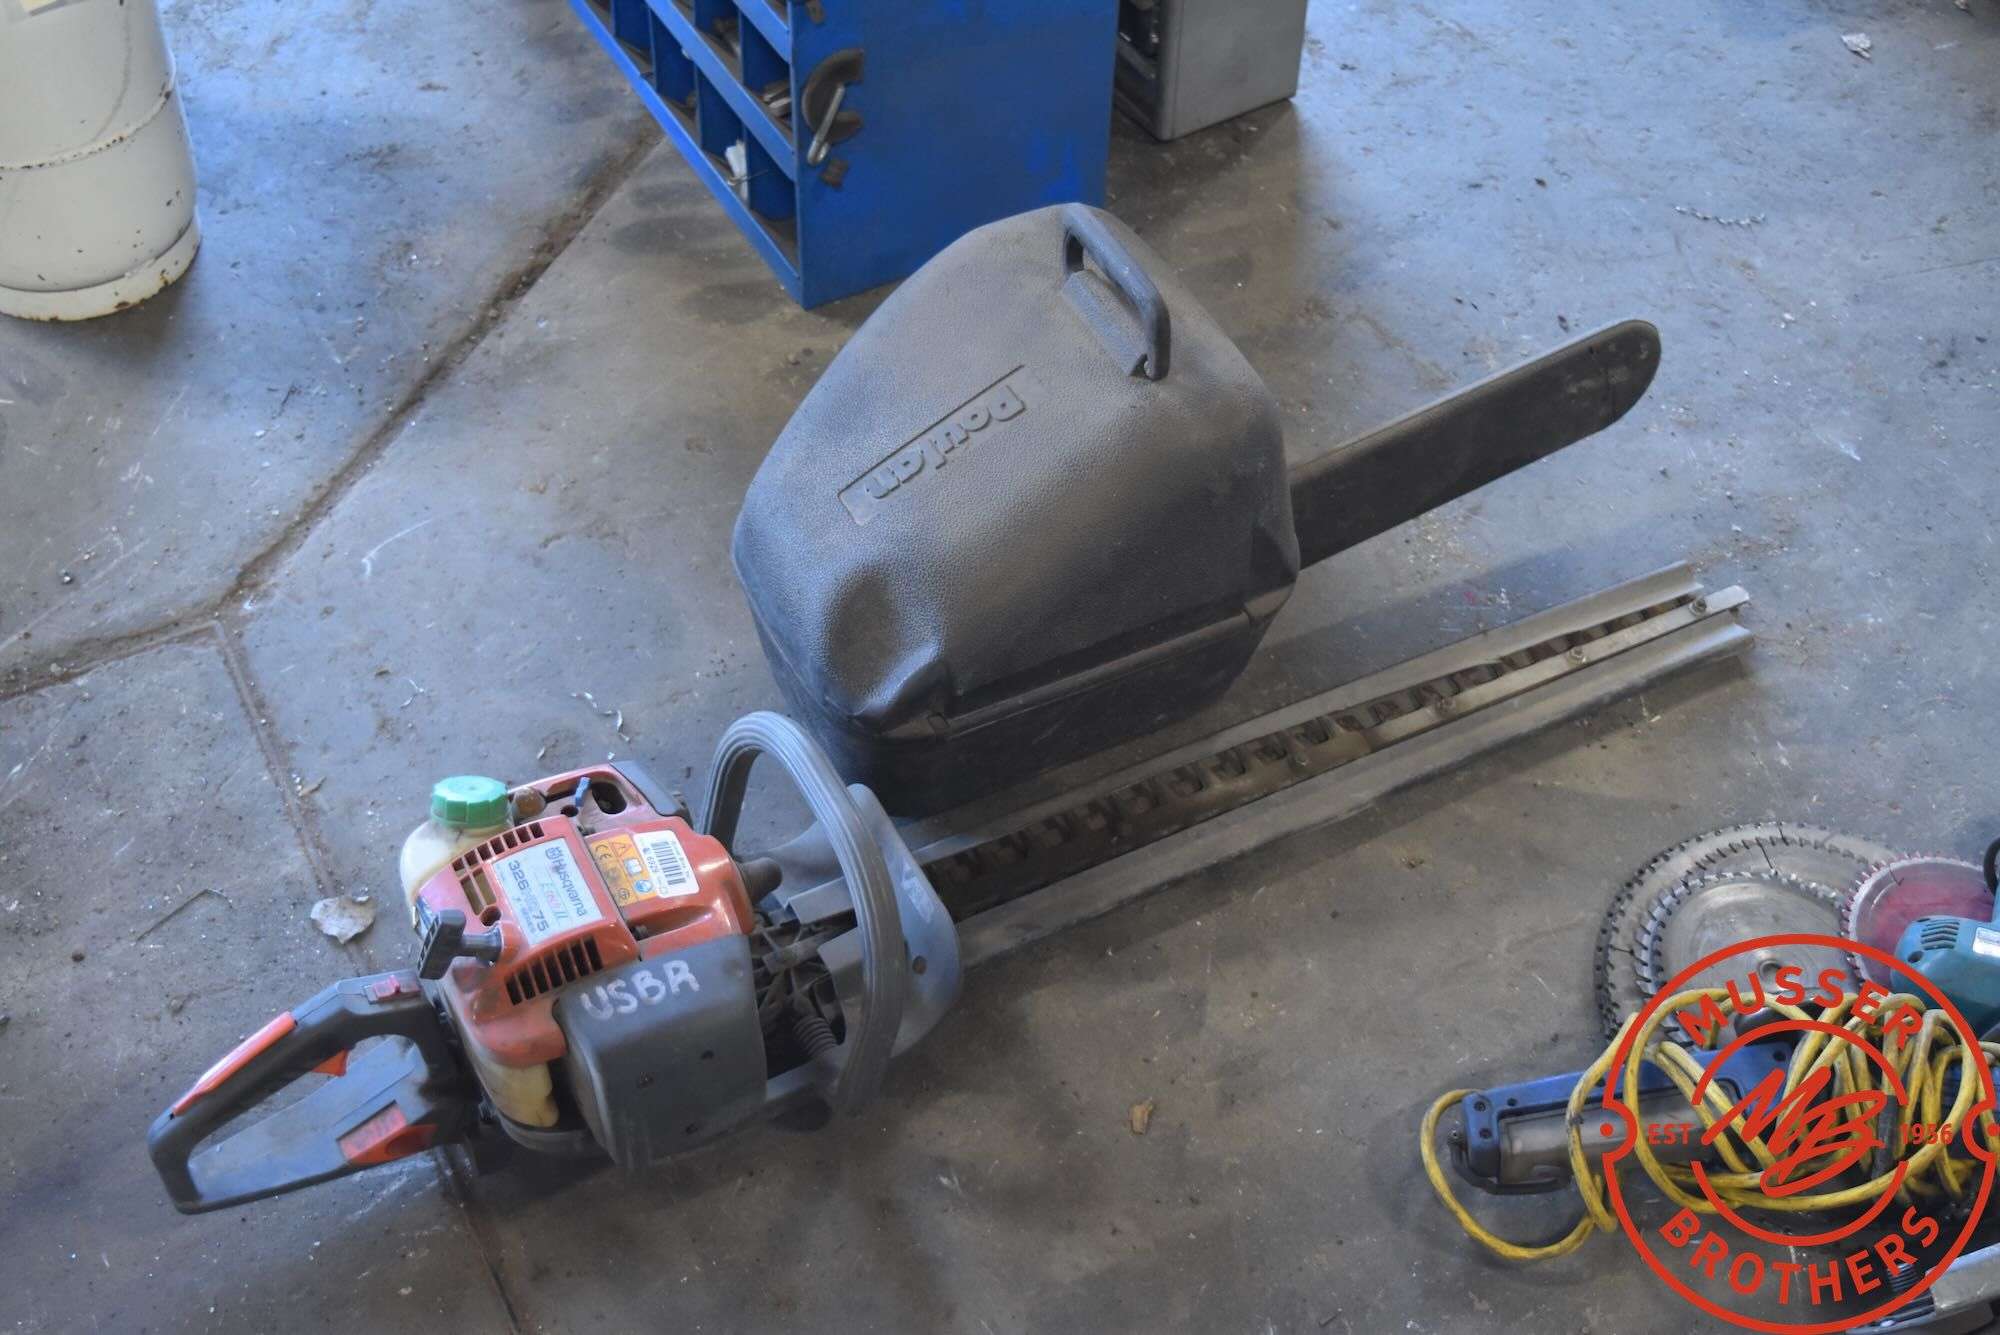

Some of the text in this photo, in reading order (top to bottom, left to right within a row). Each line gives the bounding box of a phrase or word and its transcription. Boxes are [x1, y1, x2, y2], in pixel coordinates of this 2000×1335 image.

[865, 383, 1027, 500] Poulan
[551, 855, 588, 916] Husqvarna
[580, 960, 700, 1020] USBR
